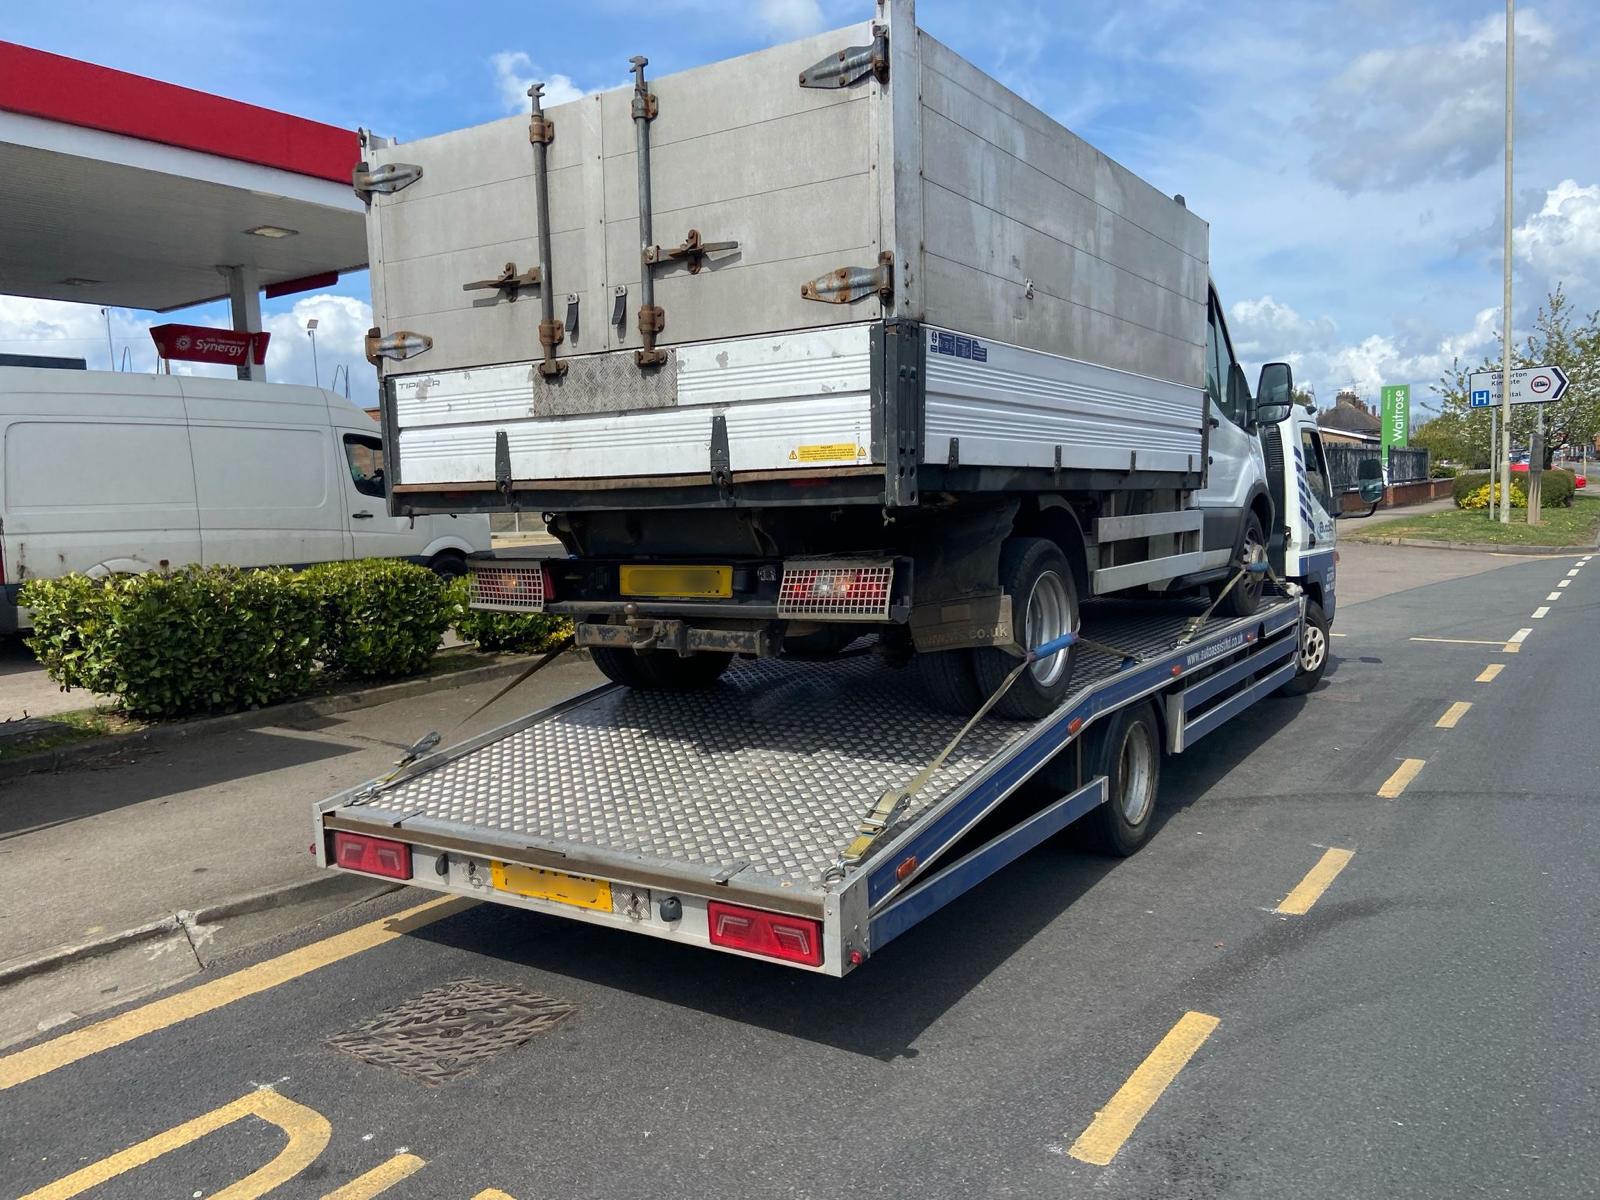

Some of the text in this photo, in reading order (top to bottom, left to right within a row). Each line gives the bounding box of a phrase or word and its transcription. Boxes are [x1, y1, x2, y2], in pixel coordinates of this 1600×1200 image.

[195, 339, 245, 356] Synergy
[1491, 379, 1521, 387] Kimote
[1475, 392, 1487, 405] H
[1491, 391, 1521, 399] Hoital
[1392, 390, 1405, 442] Waitrose
